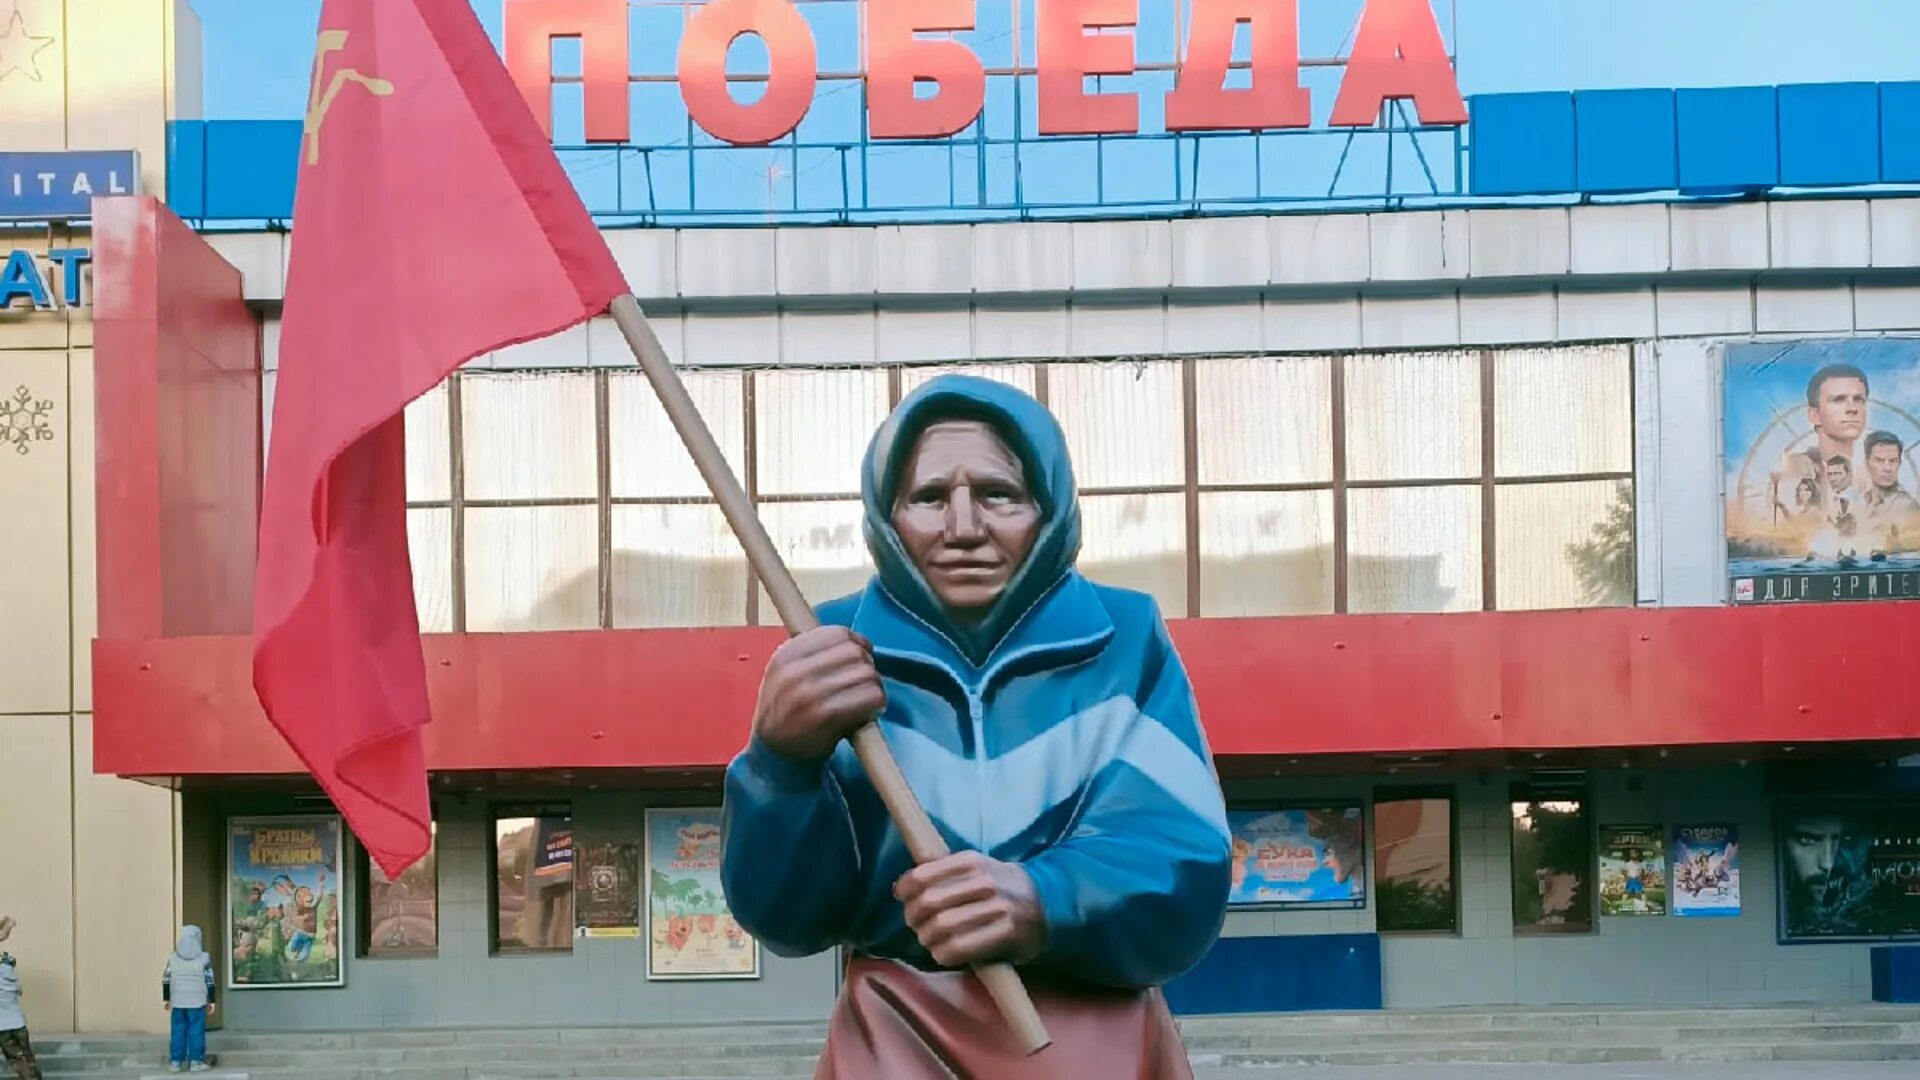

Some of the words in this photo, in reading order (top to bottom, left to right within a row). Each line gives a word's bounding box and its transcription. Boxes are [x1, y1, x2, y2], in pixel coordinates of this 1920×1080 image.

[503, 0, 1470, 145] ПОБЕДА
[13, 171, 126, 196] ITAL
[1832, 573, 1920, 597] ЗРИТЕ
